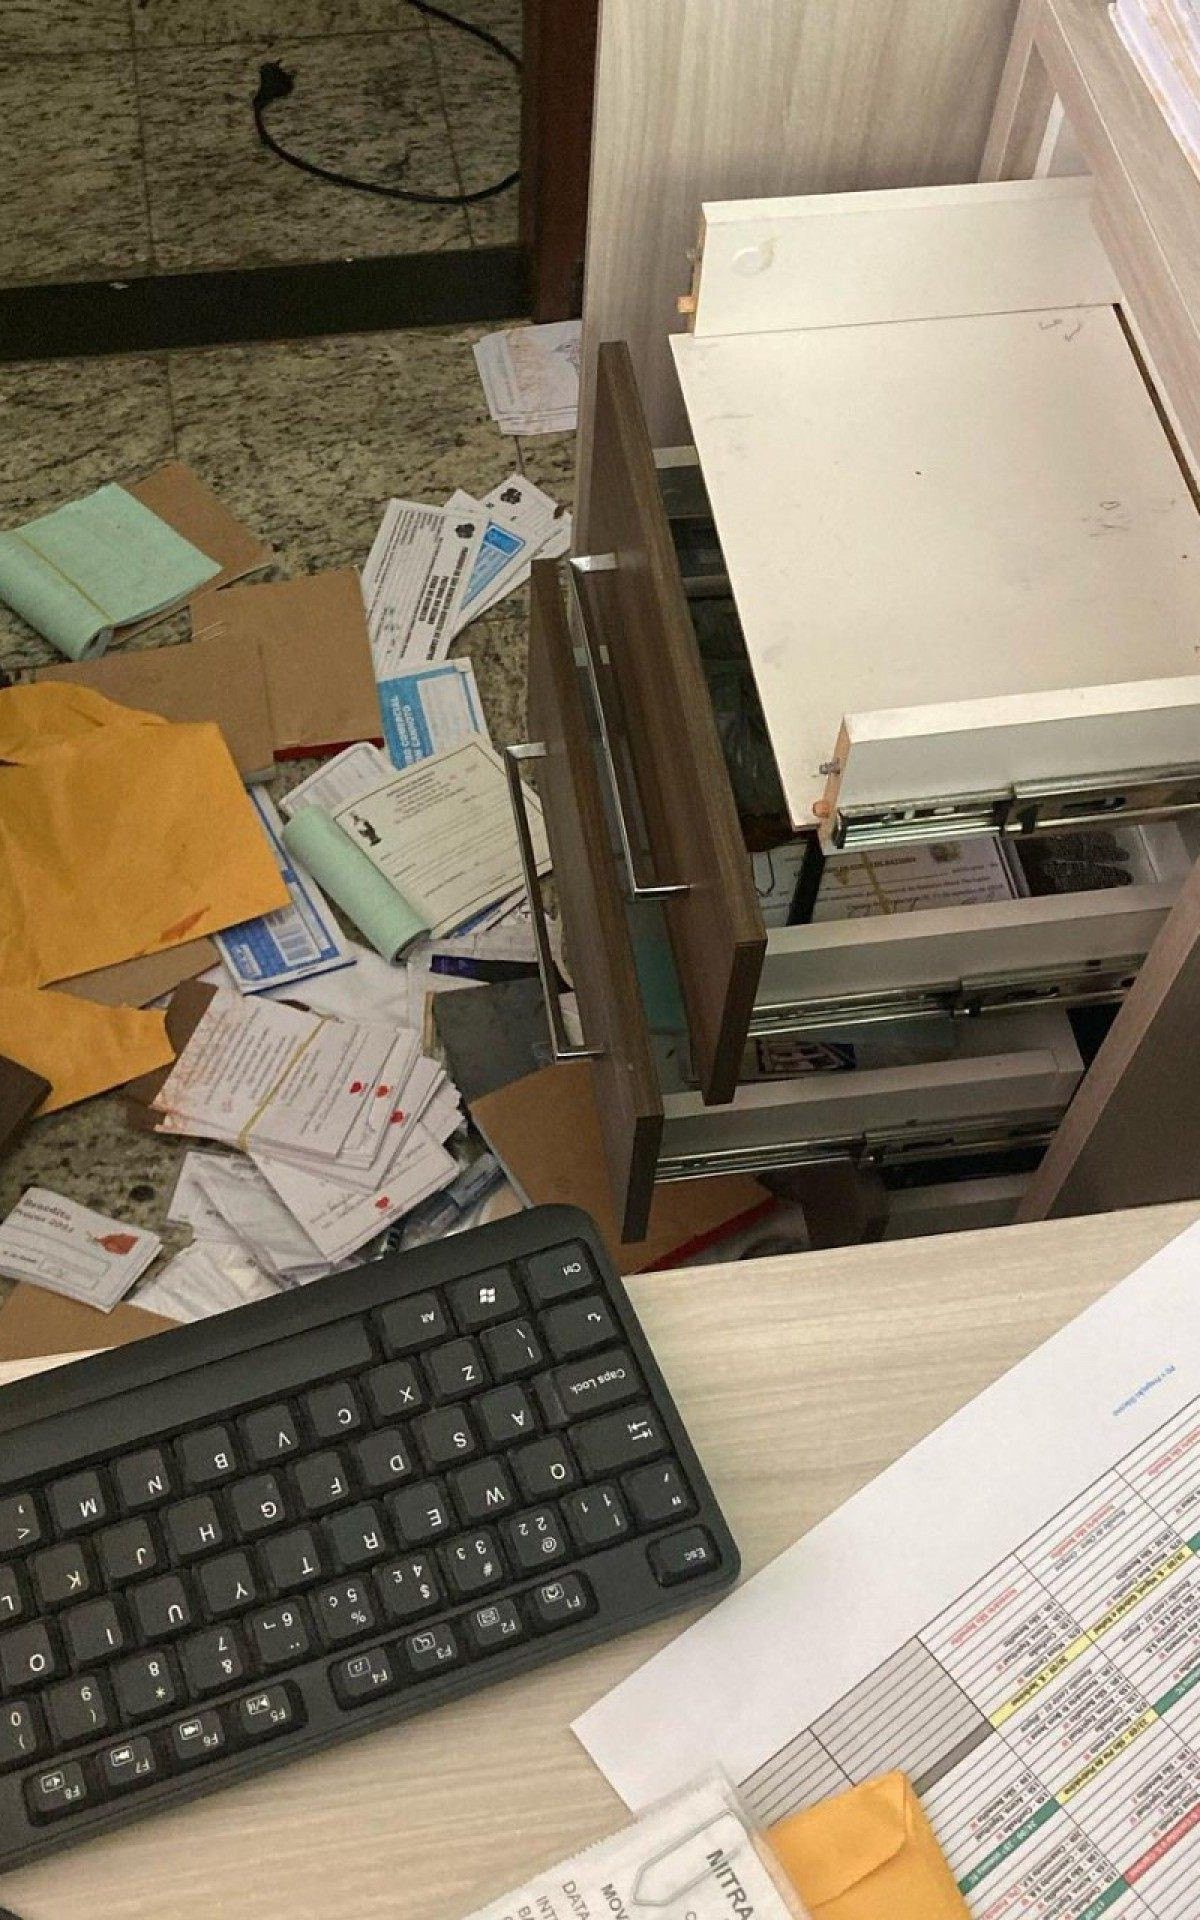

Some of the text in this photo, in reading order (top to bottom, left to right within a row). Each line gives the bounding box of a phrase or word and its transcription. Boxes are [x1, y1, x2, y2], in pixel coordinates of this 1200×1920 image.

[564, 1263, 581, 1275] Ctrl
[421, 1311, 434, 1322] Alt
[462, 1365, 474, 1380] Z
[570, 1369, 625, 1394] Caps Lock
[400, 1387, 414, 1402] X
[338, 1409, 351, 1424] C
[512, 1411, 523, 1425] A
[279, 1432, 291, 1447] V
[454, 1432, 466, 1447] S
[215, 1453, 228, 1468] B
[390, 1455, 404, 1470] D
[148, 1476, 162, 1493] N
[331, 1478, 341, 1494] F
[487, 1487, 504, 1504] W
[603, 1494, 611, 1506] 1
[81, 1499, 96, 1516] M
[261, 1502, 276, 1518] G
[427, 1509, 441, 1526] E
[200, 1524, 214, 1542] H
[519, 1517, 546, 1535] 2 2
[18, 1528, 30, 1539] <
[364, 1533, 378, 1549] R
[542, 1537, 556, 1552] @
[137, 1548, 145, 1564] J
[457, 1540, 486, 1559] 3 3
[684, 1548, 705, 1560] Esc
[303, 1557, 313, 1574] T
[414, 1565, 422, 1577] 4
[484, 1562, 492, 1576] #
[67, 1571, 81, 1589] K
[237, 1583, 247, 1599] Y
[347, 1589, 357, 1602] 5
[420, 1584, 429, 1598] $
[2, 1596, 13, 1610] L
[567, 1596, 580, 1608] F1
[168, 1605, 183, 1623] U
[282, 1613, 292, 1626] 6
[351, 1611, 366, 1624] %
[501, 1620, 515, 1633] F2
[219, 1637, 227, 1650] 7
[437, 1645, 451, 1659] F3
[30, 1654, 45, 1671] O
[149, 1662, 159, 1676] 8
[222, 1659, 231, 1673] &
[372, 1670, 387, 1683] F4
[81, 1687, 91, 1700] 9
[12, 1713, 21, 1726] 0
[270, 1709, 285, 1722] F5
[204, 1734, 218, 1746] F6
[136, 1759, 150, 1773] F7
[65, 1785, 80, 1799] F8
